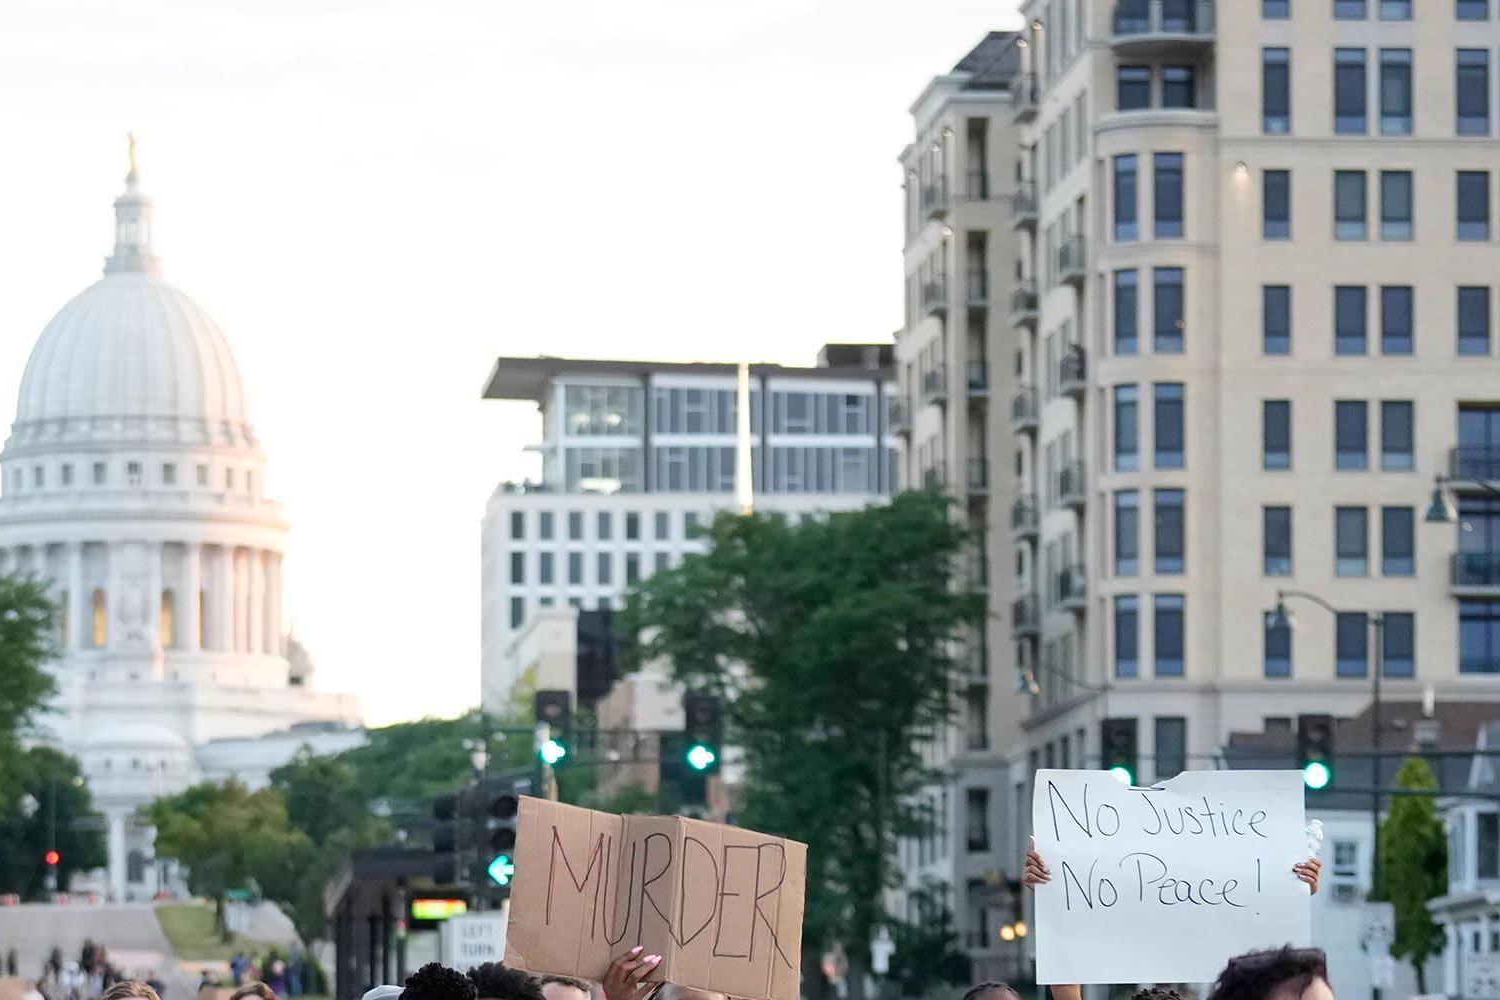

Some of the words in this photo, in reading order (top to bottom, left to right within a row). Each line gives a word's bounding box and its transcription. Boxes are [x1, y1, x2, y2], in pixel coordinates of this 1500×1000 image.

[1048, 780, 1121, 842] No
[1127, 786, 1268, 838] Justice
[546, 825, 793, 969] MURDER
[1062, 858, 1119, 911] No
